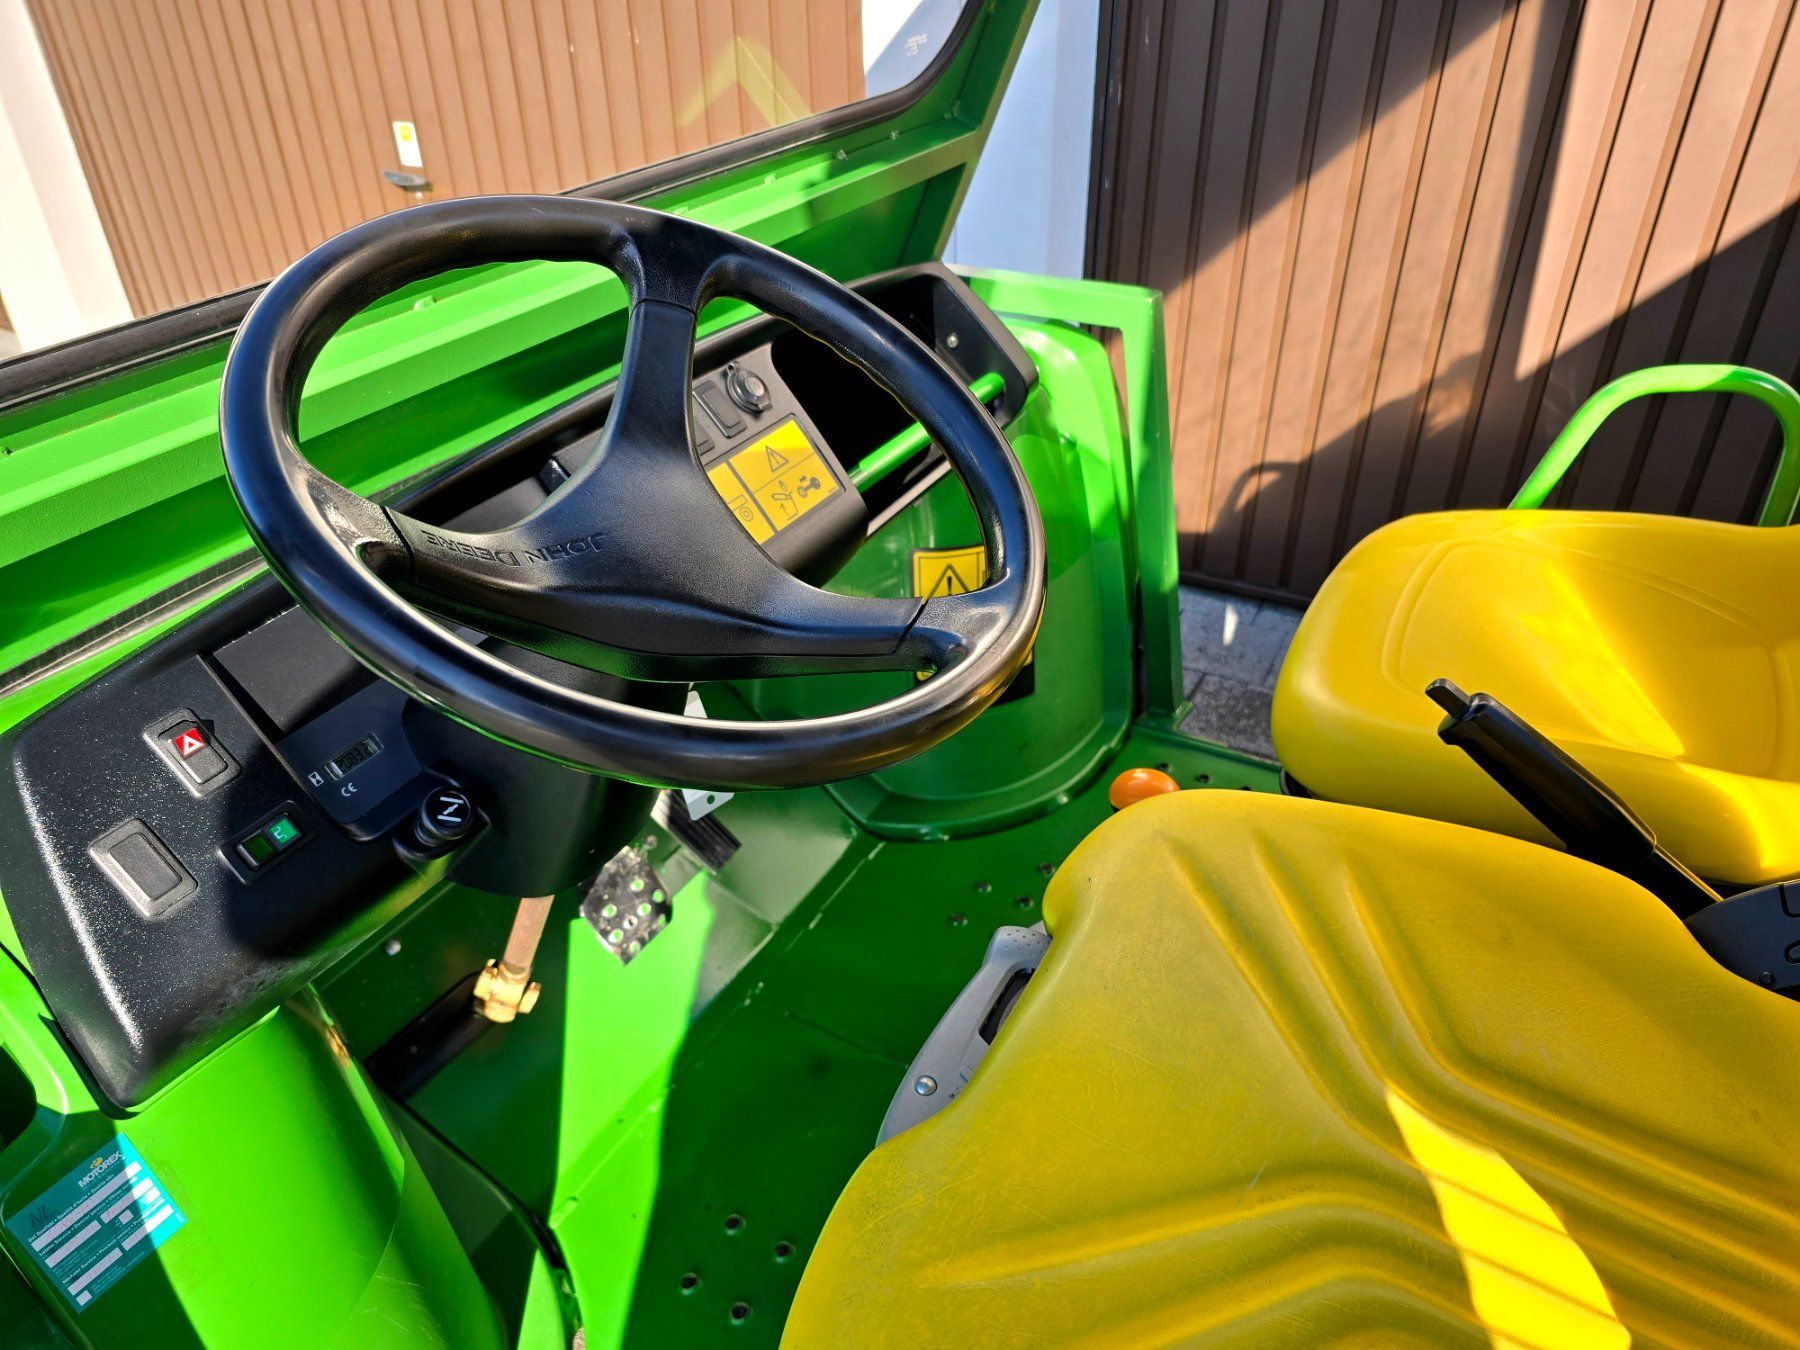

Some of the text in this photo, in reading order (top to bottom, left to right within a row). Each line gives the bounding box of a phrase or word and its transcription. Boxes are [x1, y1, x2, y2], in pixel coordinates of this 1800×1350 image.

[421, 529, 606, 567] JOHN DEERE
[341, 782, 358, 797] CE
[78, 1151, 123, 1188] MOTOREX
